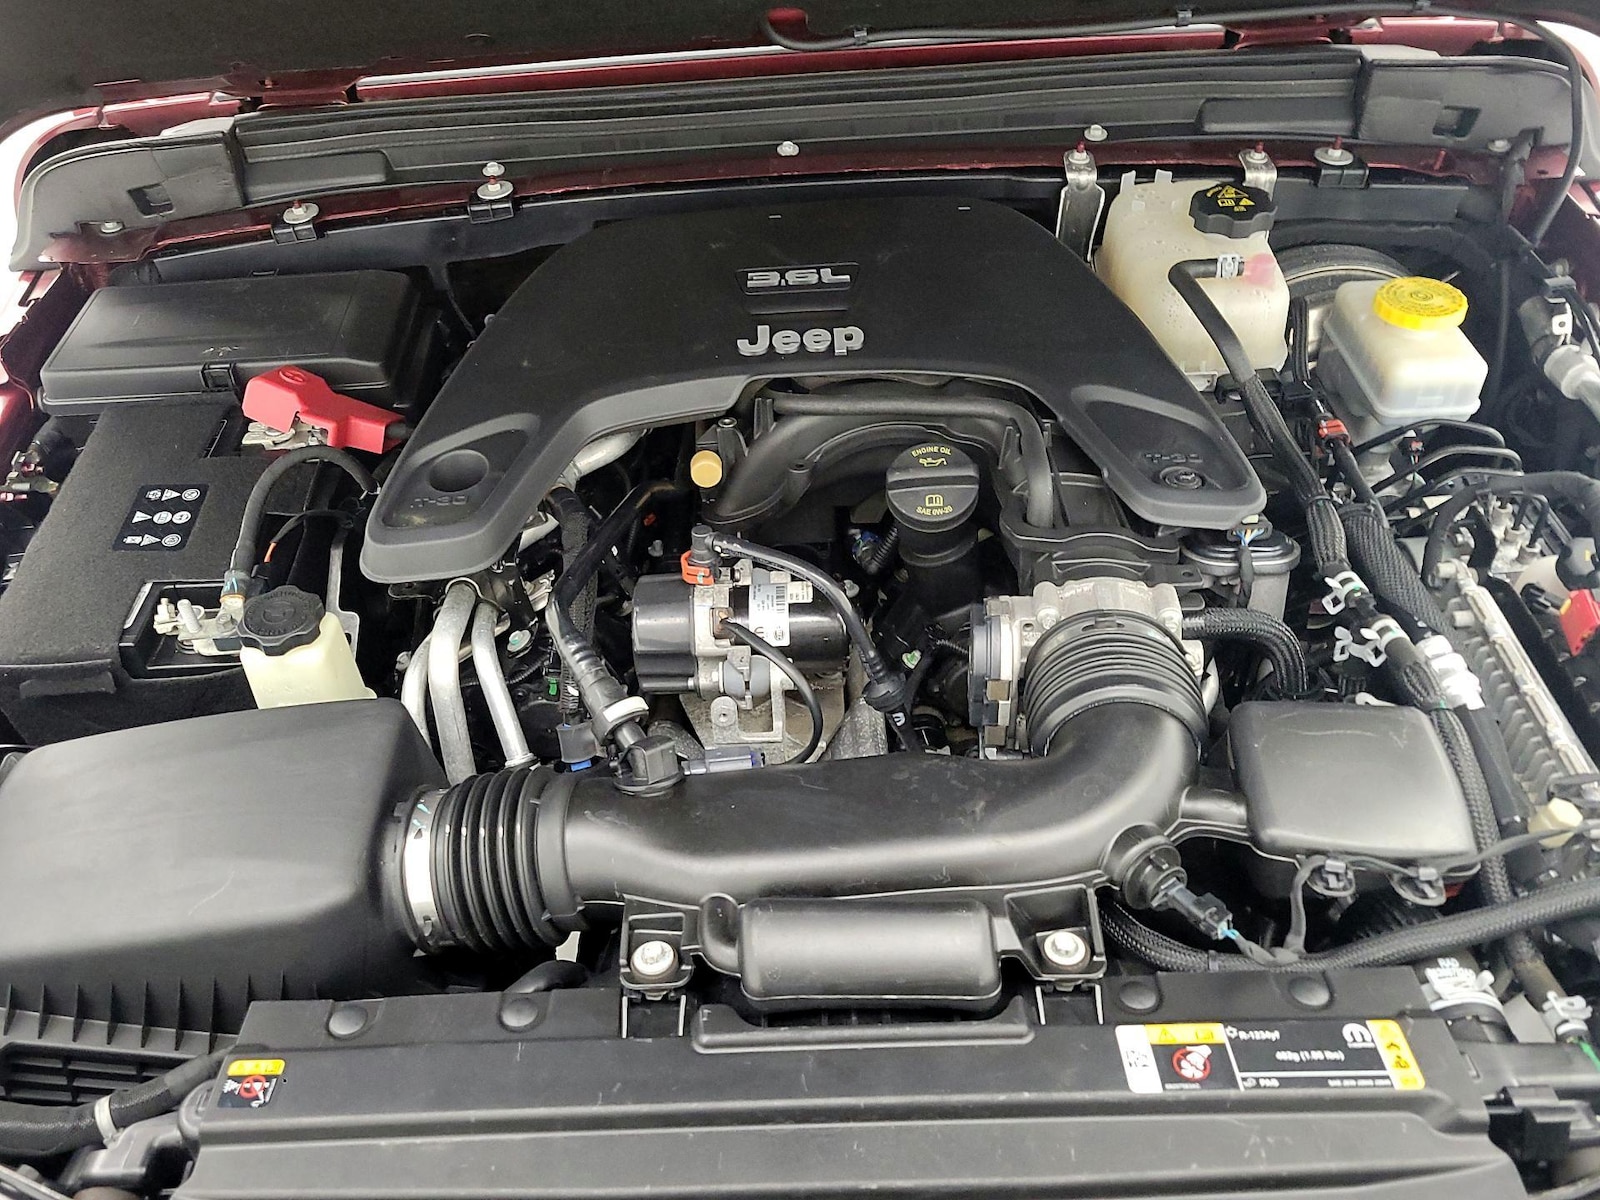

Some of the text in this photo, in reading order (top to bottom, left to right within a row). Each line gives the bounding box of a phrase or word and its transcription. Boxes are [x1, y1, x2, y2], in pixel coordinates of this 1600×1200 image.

[747, 268, 851, 288] 3.6L
[737, 325, 864, 356] Jeep
[911, 446, 952, 457] ENGINE OIL
[916, 505, 932, 515] SAE
